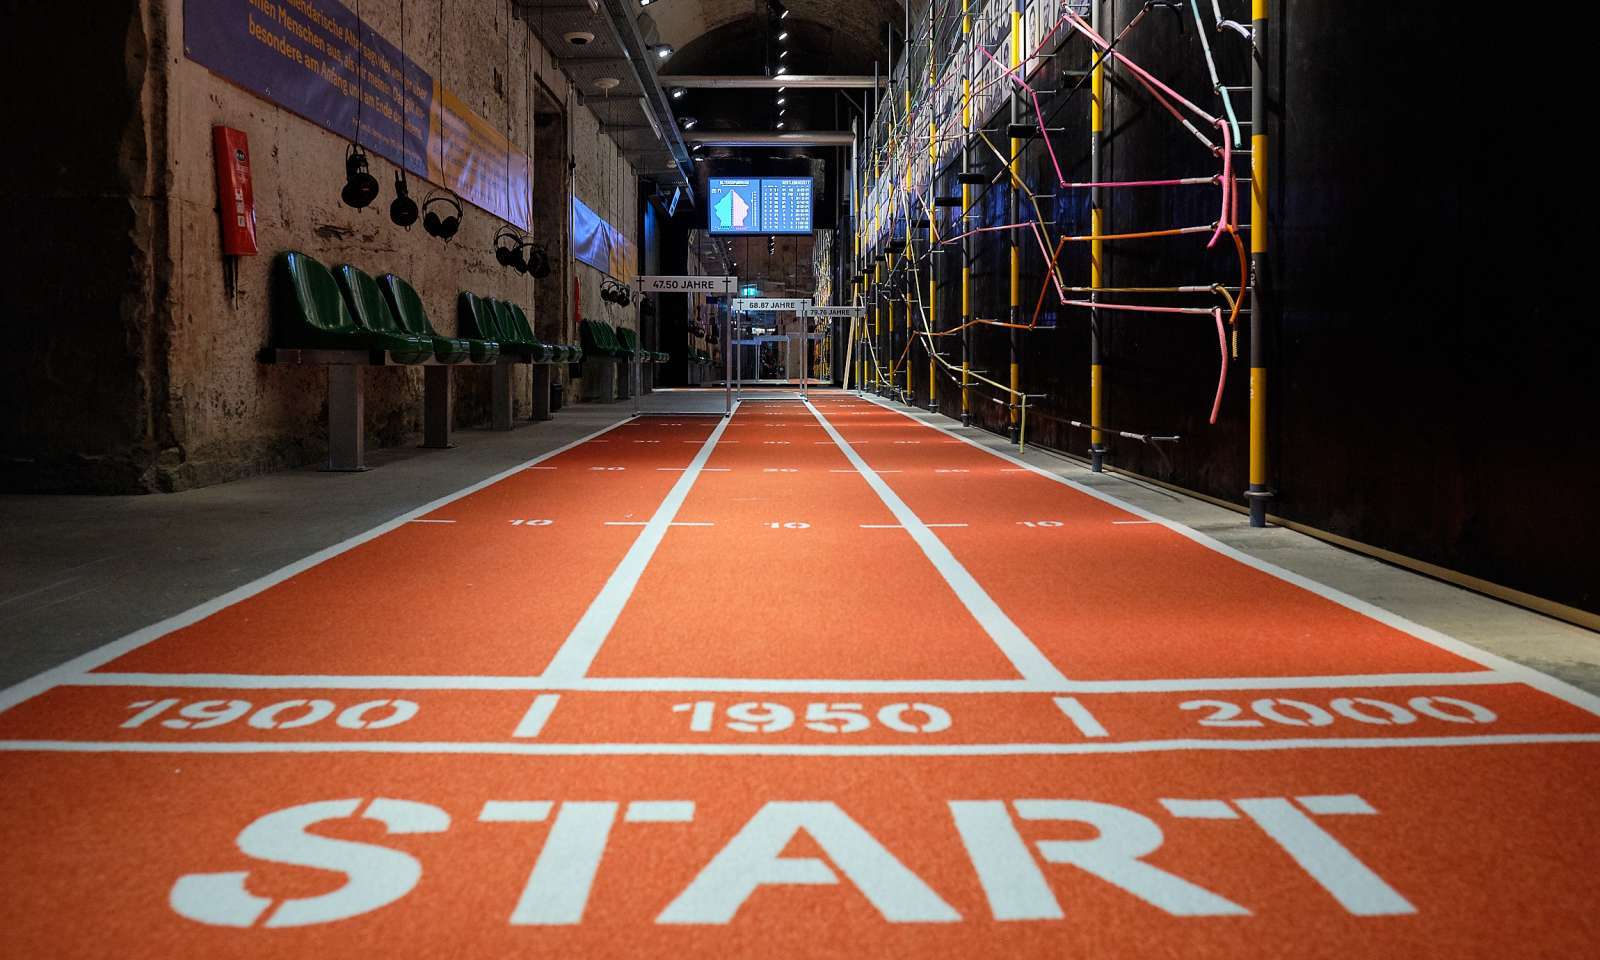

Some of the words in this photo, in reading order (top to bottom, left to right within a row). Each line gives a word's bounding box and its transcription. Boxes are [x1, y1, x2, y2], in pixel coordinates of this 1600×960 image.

[278, 5, 326, 50] Menschen
[248, 13, 303, 64] besondere
[304, 55, 319, 74] am
[320, 61, 348, 96] Anfang
[652, 280, 679, 289] 47.50
[680, 280, 714, 289] JAHRE
[507, 519, 554, 527] 10
[765, 521, 811, 529] 10
[1016, 520, 1064, 528] 10
[118, 698, 420, 730] 1900
[672, 701, 953, 734] 1950
[1179, 696, 1498, 727] 2000
[168, 793, 1419, 928] START
